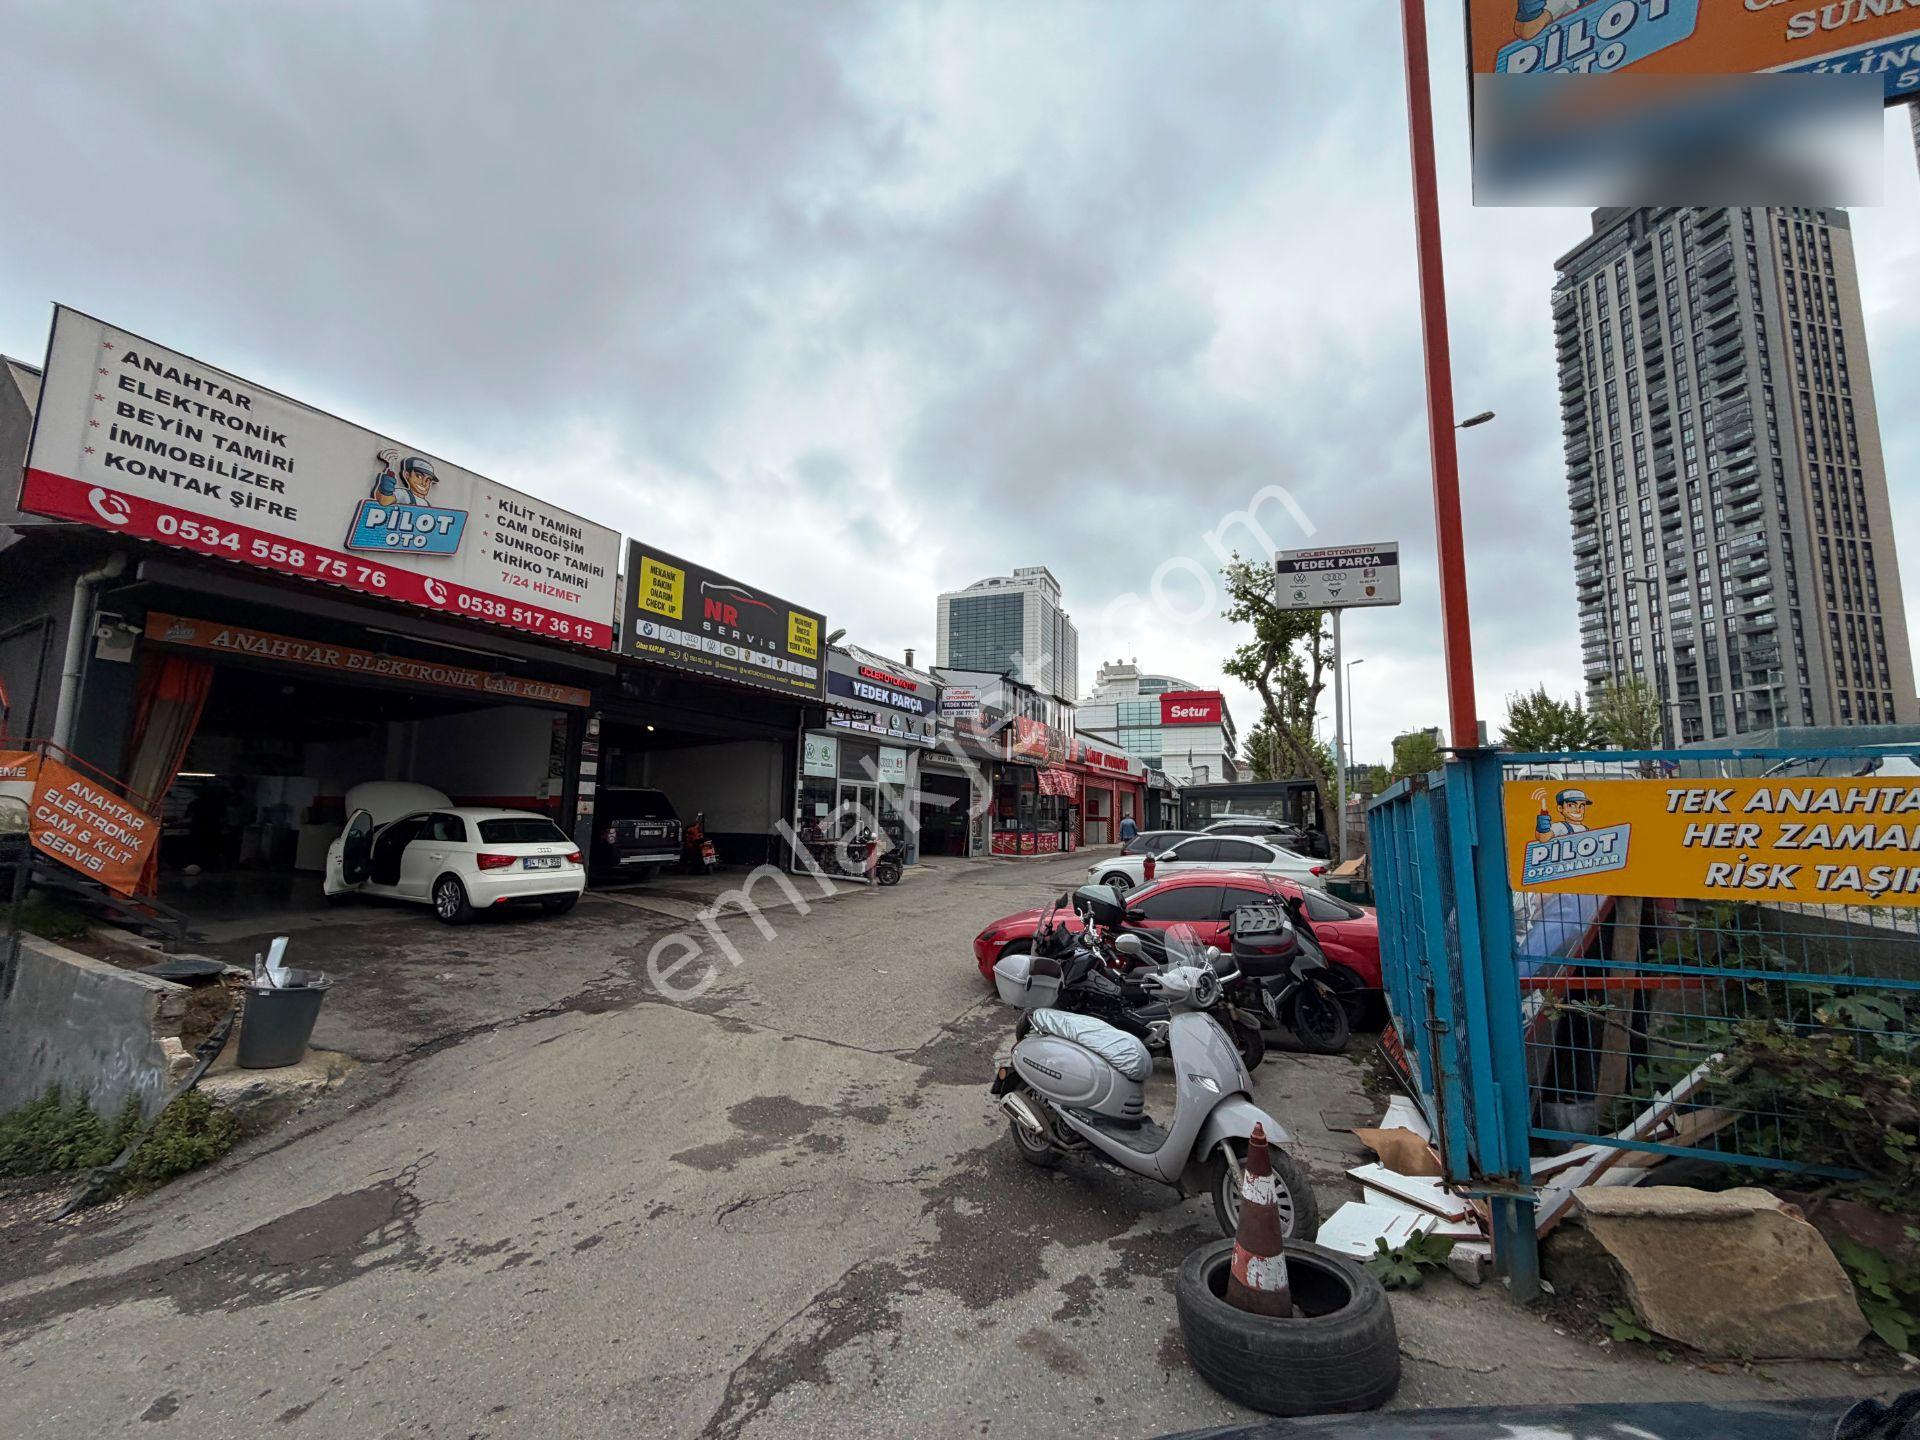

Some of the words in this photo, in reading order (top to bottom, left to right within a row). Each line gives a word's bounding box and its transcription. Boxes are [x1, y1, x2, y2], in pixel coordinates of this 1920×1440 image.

[1553, 42, 1627, 73] TO
[121, 351, 252, 411] ANAHTAR
[118, 374, 288, 449] ELEKTRONİK
[117, 401, 203, 443] BEYİN
[212, 434, 294, 473] TAMİRİ
[109, 423, 285, 495] İMMOBİLİZER
[104, 452, 222, 500] KONTAK
[229, 490, 298, 522] ŞİFRE
[365, 506, 456, 536] PİLOT
[497, 515, 528, 536] CAM
[531, 527, 585, 555] DEĞİŞİM
[498, 499, 536, 522] KİLİT
[539, 515, 582, 540] TAMİRİ
[156, 514, 241, 551] 0534
[251, 539, 305, 567] 558
[315, 555, 348, 578] 75
[356, 566, 387, 588] 76
[385, 532, 428, 549] OTO
[495, 532, 560, 562] SUNROOF
[564, 556, 605, 578] TAMİRİ
[493, 550, 542, 575] KİRİKO
[546, 567, 589, 590] TAMİRİ
[650, 566, 676, 582] MEKANİK
[1293, 559, 1335, 571] YEDEK
[1338, 556, 1381, 569] PARÇA
[501, 571, 529, 589] 7/24
[533, 581, 582, 604] HİZMET
[646, 598, 665, 610] CHECK
[668, 605, 676, 614] UP
[458, 593, 506, 619] 0538
[511, 606, 545, 628] 517
[549, 617, 570, 635] 36
[575, 624, 593, 640] 15
[704, 597, 738, 627] NR
[702, 621, 776, 650] SERVİS
[209, 630, 341, 666] ANAHTAR
[346, 654, 479, 687] ELEKTRONİK
[484, 676, 517, 693] CAM
[523, 682, 564, 700] KİLİT
[853, 681, 890, 704] YEDEK
[891, 692, 922, 713] PARÇA
[1170, 705, 1210, 718] Setur
[44, 788, 144, 851] ELEKTRONİK
[67, 782, 144, 831] ANAHTAR
[1666, 787, 1735, 814] TEK
[35, 806, 77, 835] CAM
[77, 830, 92, 844] &
[93, 838, 133, 864] KİLİT
[39, 831, 106, 873] SERVİSİ
[1531, 831, 1618, 867] PİLOT
[1682, 823, 1762, 849] HER
[1528, 866, 1554, 878] OTO
[1557, 854, 1620, 873] ANAHTAR
[1704, 853, 1802, 890] RİSK
